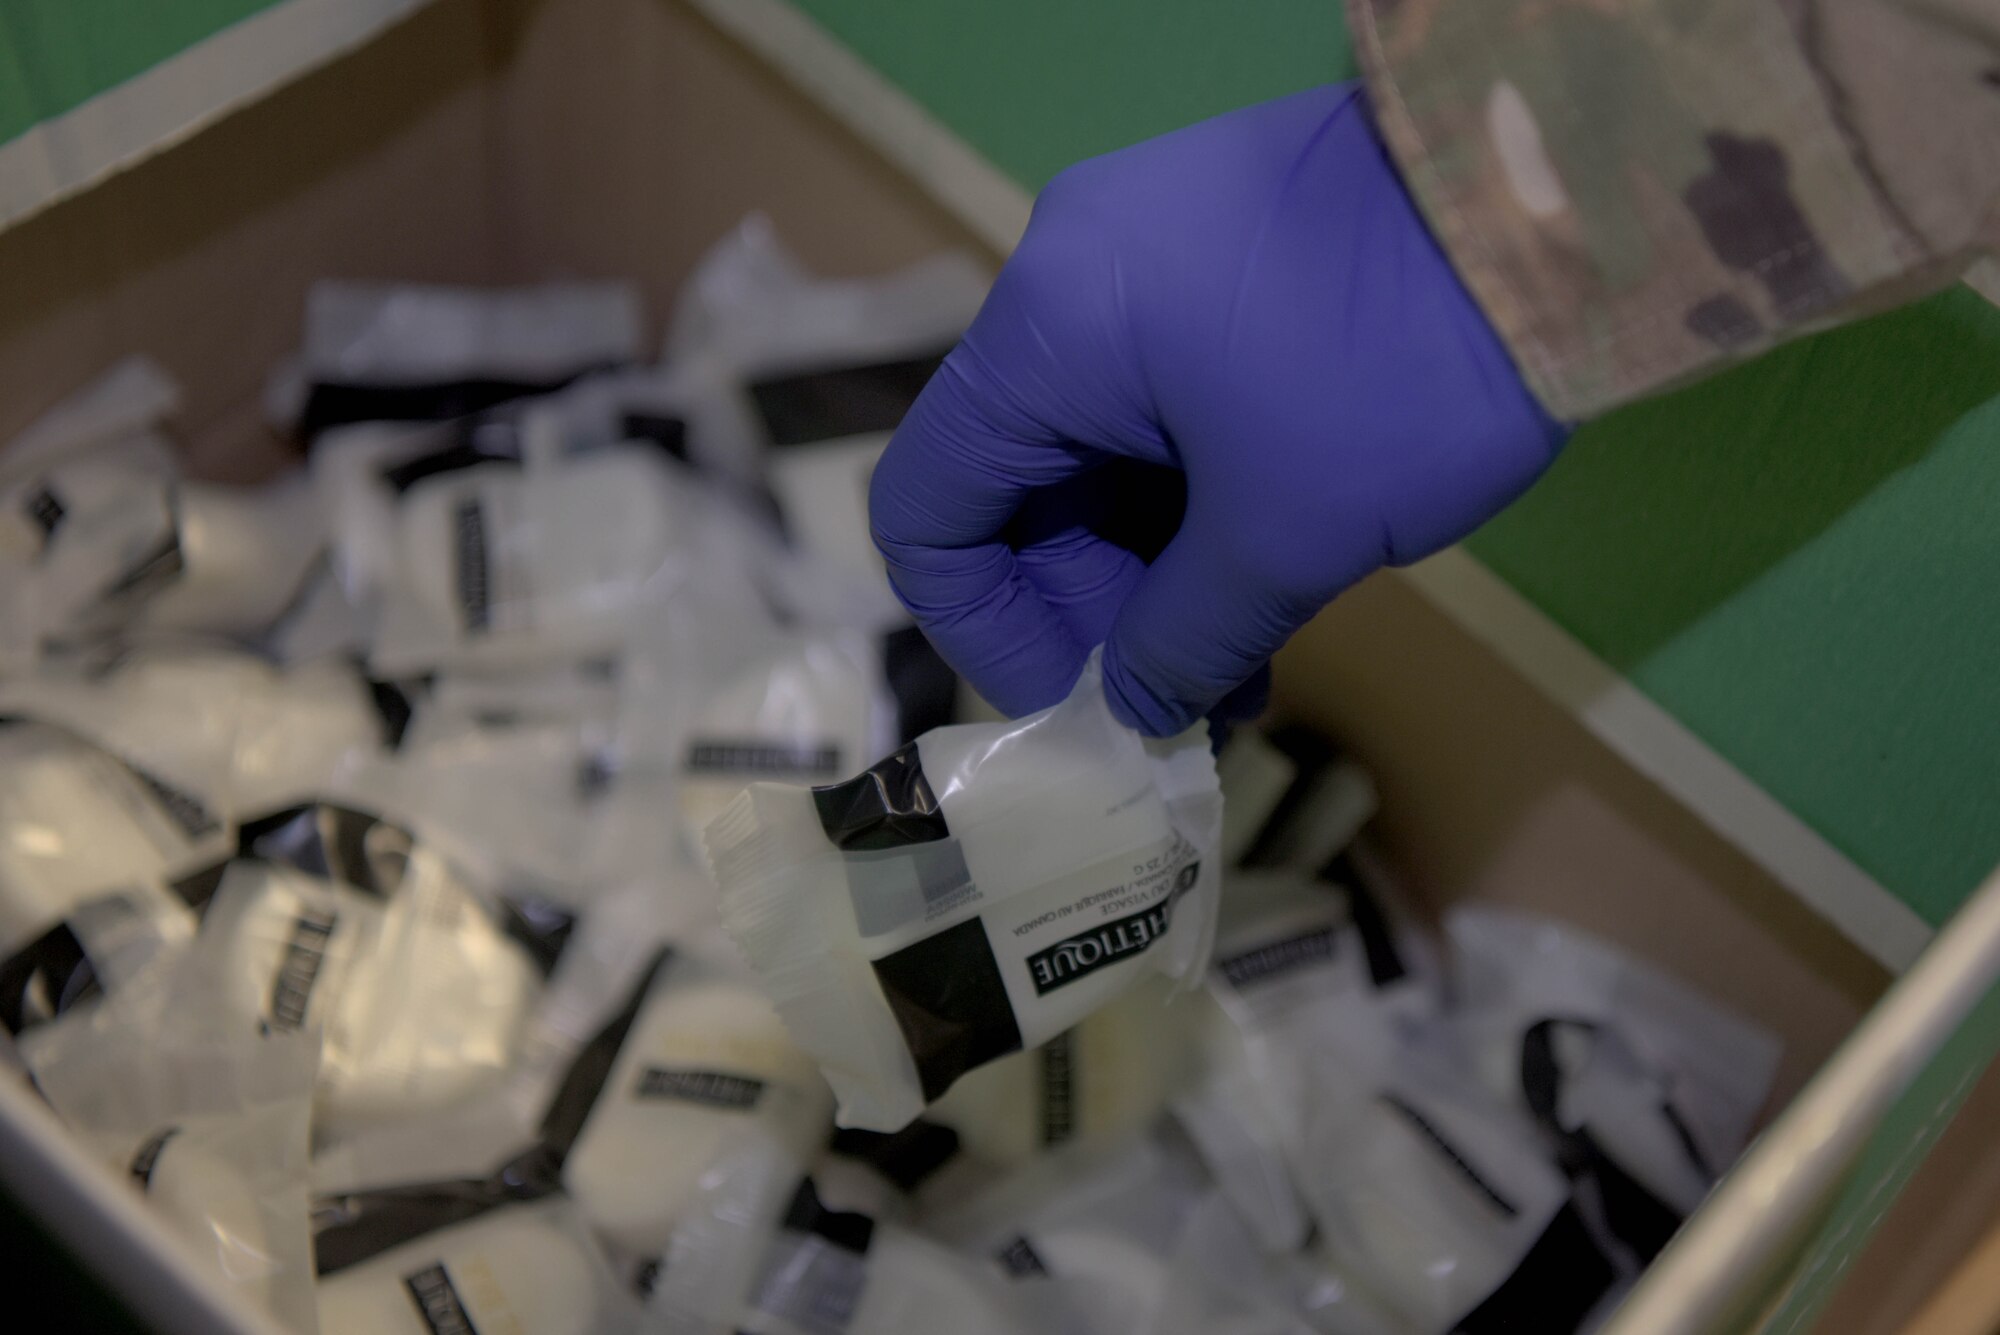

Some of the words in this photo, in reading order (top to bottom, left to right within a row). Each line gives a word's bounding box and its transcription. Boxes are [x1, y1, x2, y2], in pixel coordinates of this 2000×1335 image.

[1133, 863, 1144, 876] G
[1146, 857, 1160, 871] 25
[1101, 891, 1148, 916] VISAGE
[1056, 904, 1073, 919] AU
[1012, 910, 1057, 938] CANADA
